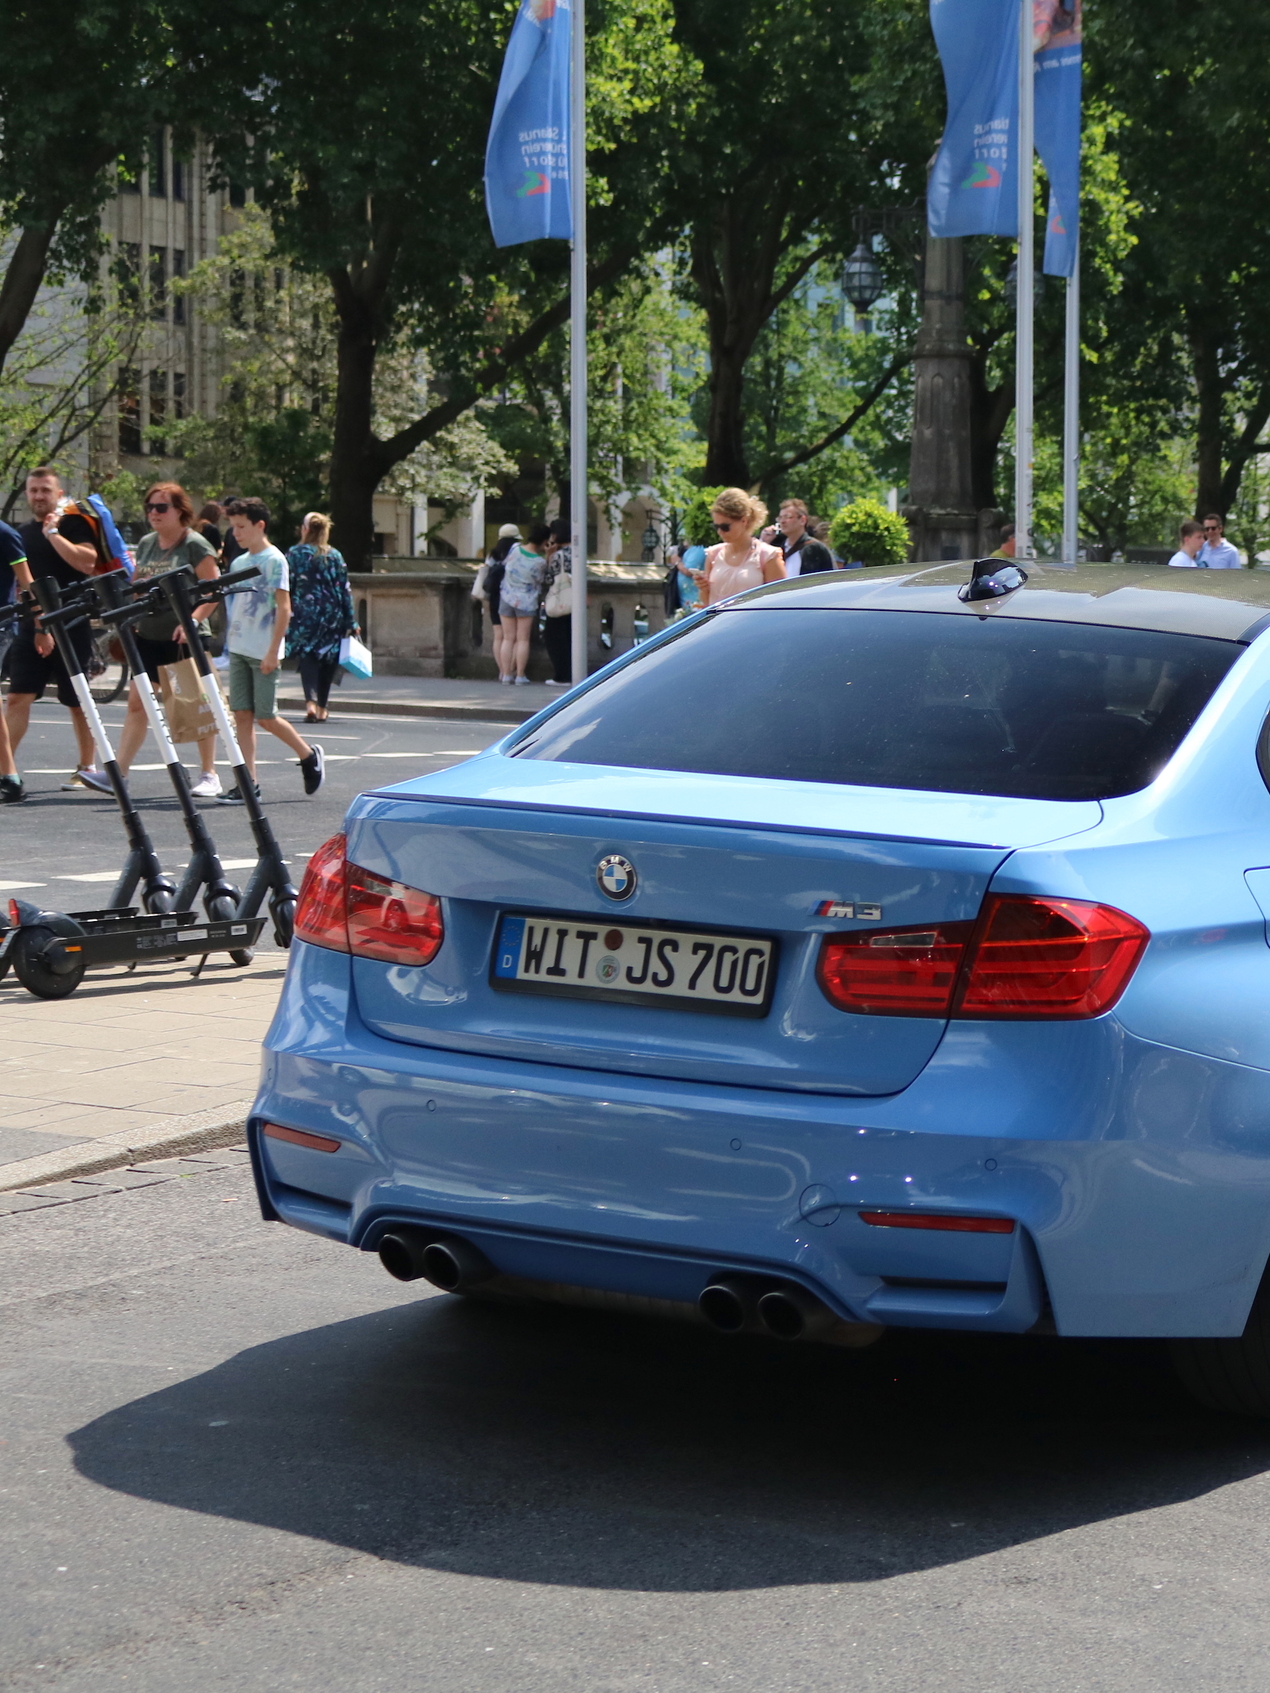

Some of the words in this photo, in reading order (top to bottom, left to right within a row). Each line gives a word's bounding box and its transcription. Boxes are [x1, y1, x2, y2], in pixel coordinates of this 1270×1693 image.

[599, 855, 633, 872] BMW
[813, 900, 882, 921] M3
[502, 954, 513, 969] D
[523, 925, 599, 979] WIT
